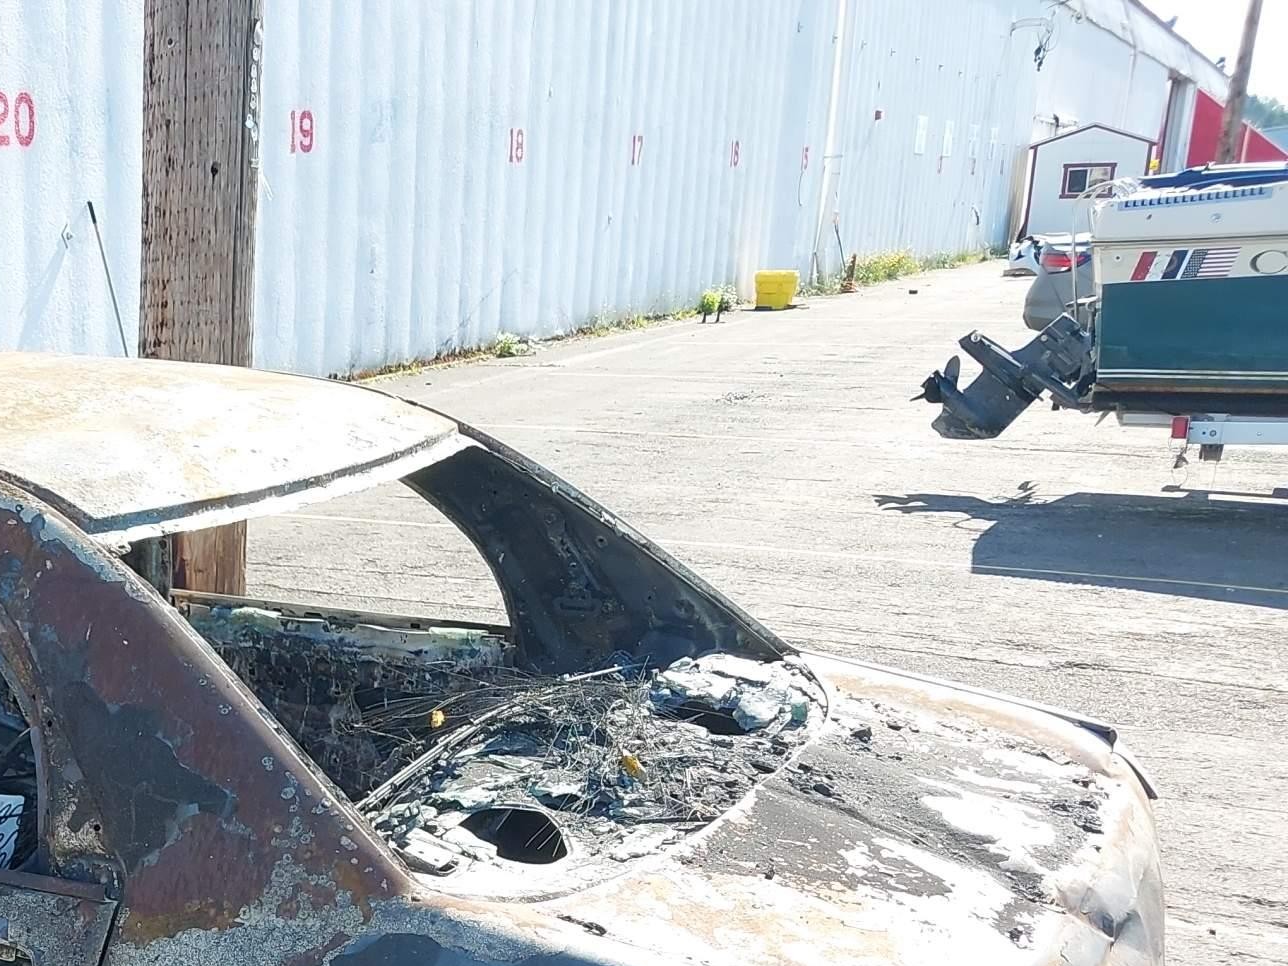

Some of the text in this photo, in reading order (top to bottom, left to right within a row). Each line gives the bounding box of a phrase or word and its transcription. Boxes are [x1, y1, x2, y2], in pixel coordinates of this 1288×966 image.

[290, 110, 314, 153] 19
[508, 127, 524, 163] 18
[631, 135, 644, 166] 17
